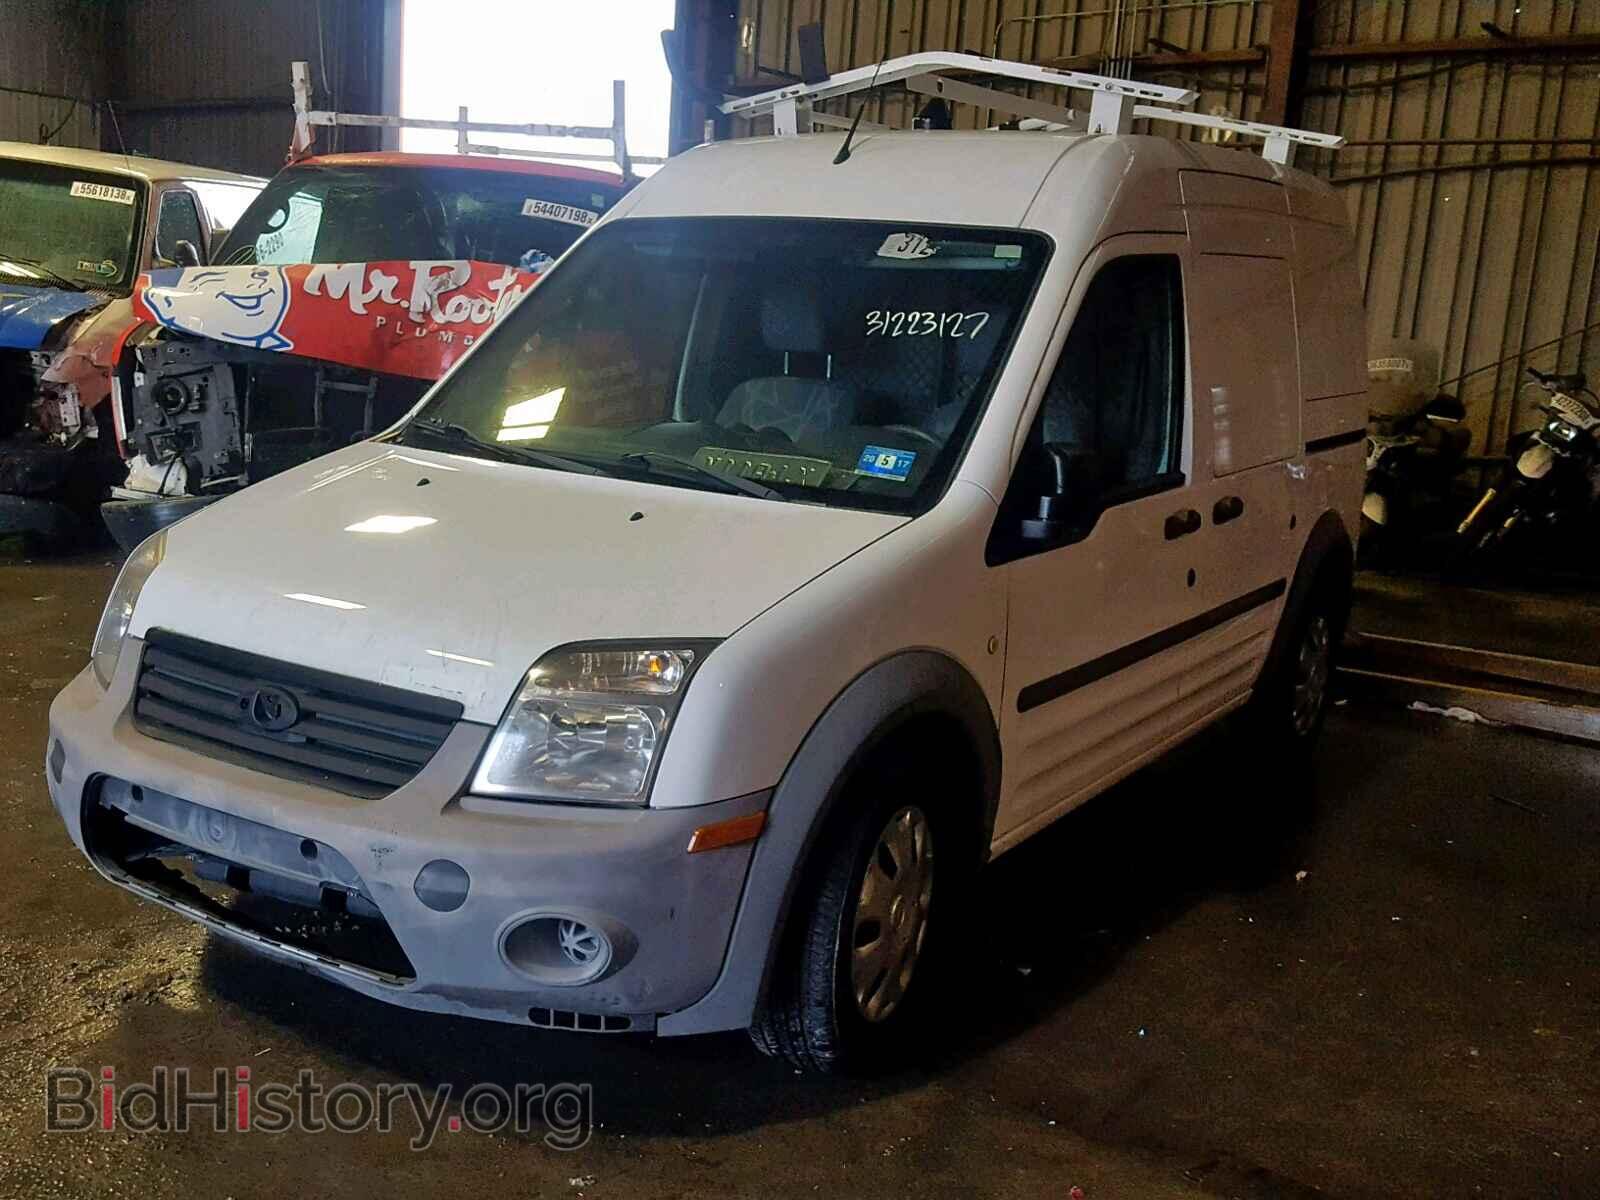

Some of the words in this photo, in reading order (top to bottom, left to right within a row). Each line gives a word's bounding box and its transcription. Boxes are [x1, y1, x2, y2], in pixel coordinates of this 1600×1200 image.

[865, 311, 990, 340] 31223127
[880, 455, 891, 466] 5
[897, 460, 911, 469] 17
